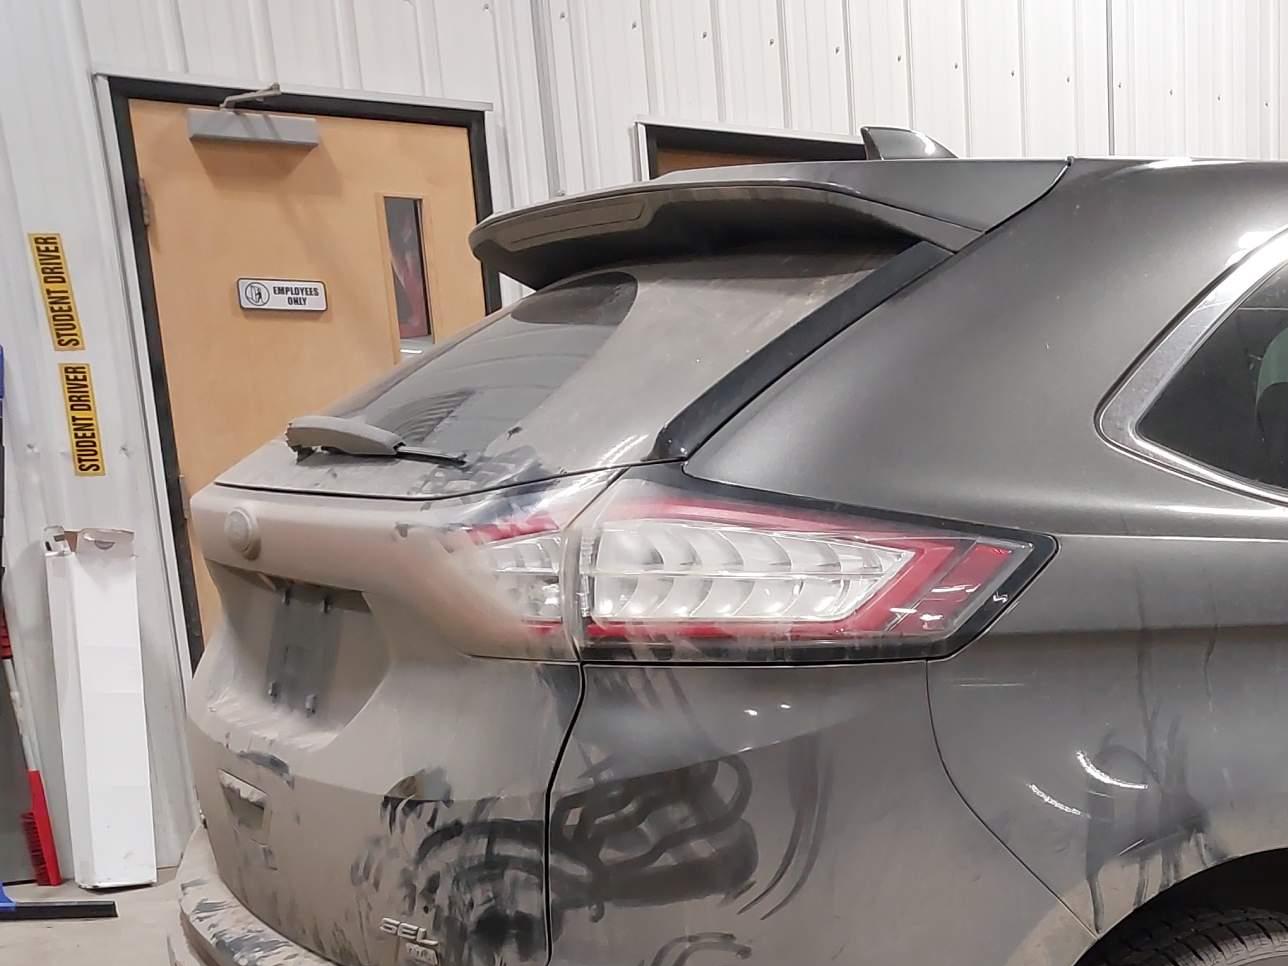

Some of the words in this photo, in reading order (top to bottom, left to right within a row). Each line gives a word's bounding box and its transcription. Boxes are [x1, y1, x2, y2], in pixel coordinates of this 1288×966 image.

[34, 236, 66, 284] DRIVER
[273, 286, 319, 296] EMPLOYEES
[287, 296, 307, 305] ONLY
[47, 288, 80, 347] STUDENT
[63, 366, 91, 411] DRIVER
[72, 415, 100, 472] STUDENT
[380, 917, 439, 946] SEL
